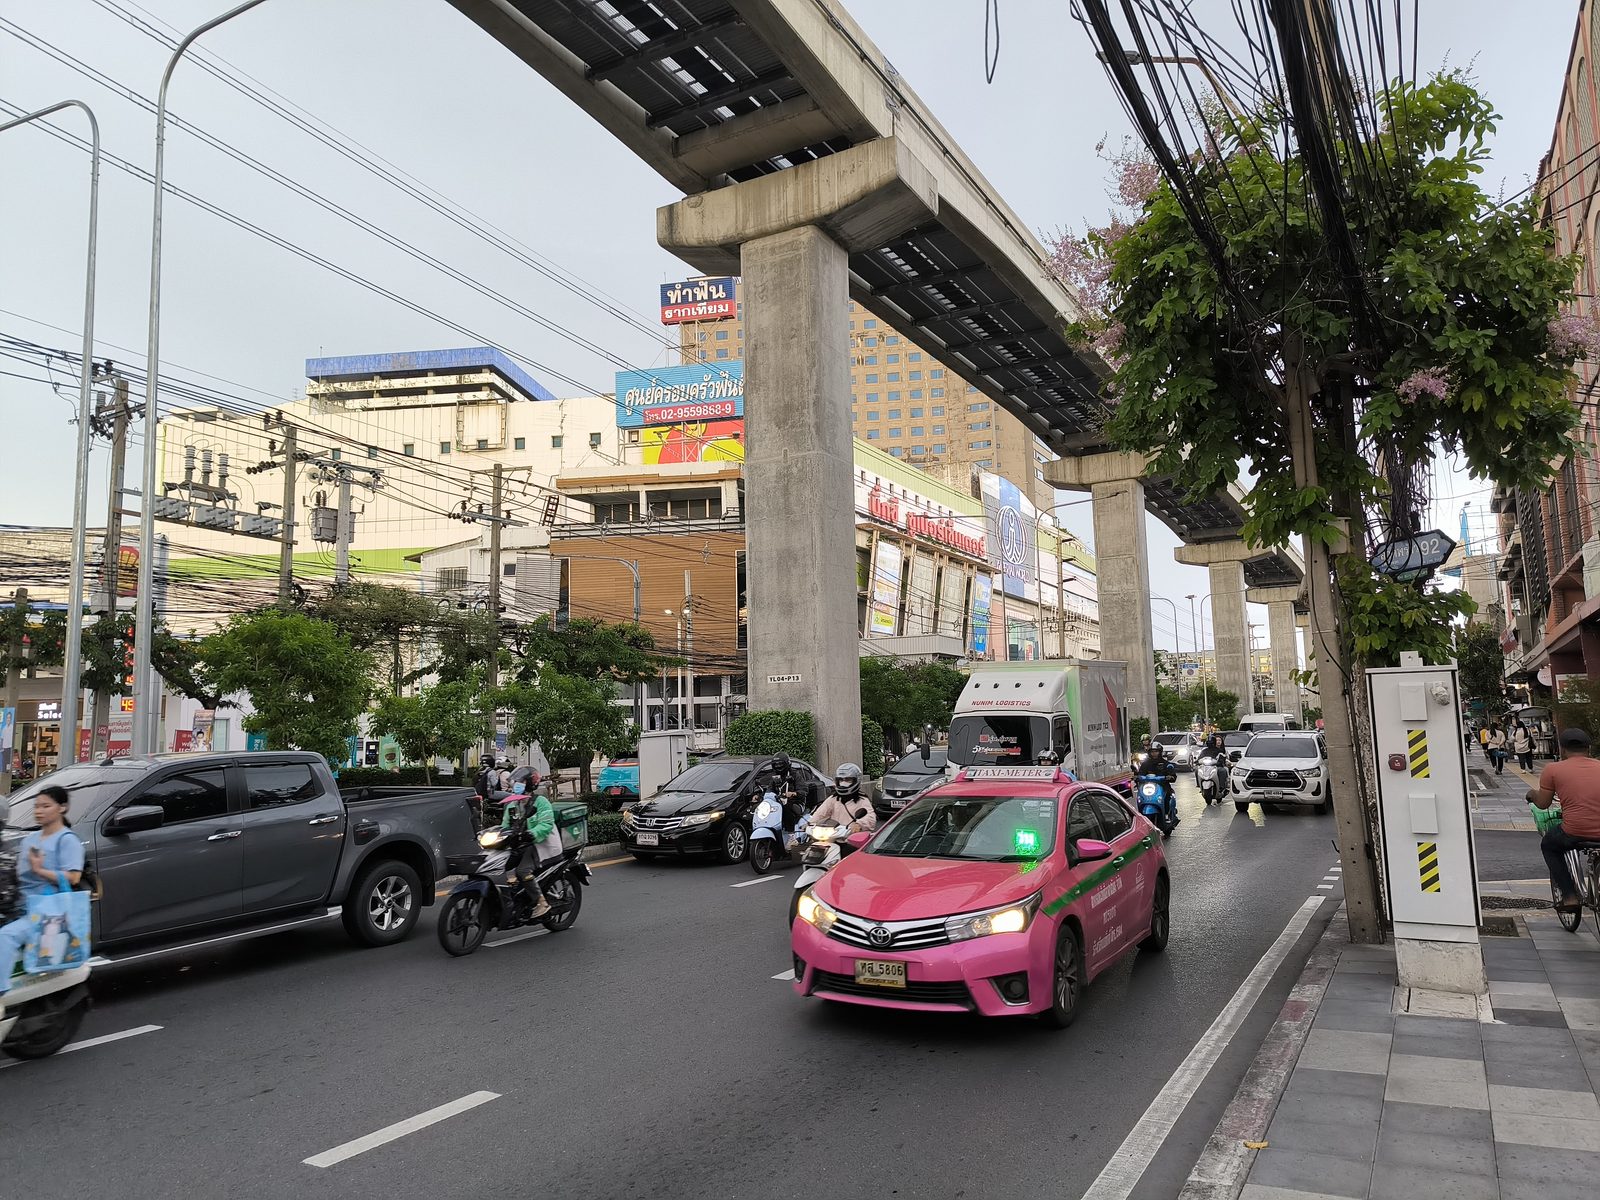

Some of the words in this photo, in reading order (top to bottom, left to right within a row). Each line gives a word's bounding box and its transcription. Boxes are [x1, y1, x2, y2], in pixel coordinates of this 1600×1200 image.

[666, 280, 726, 304] ทำฟัน
[664, 302, 729, 319] รากเทียม
[1421, 538, 1440, 556] 92
[37, 711, 62, 719] Selec
[974, 769, 1043, 777] TAXI-METER
[878, 963, 904, 976] 5806
